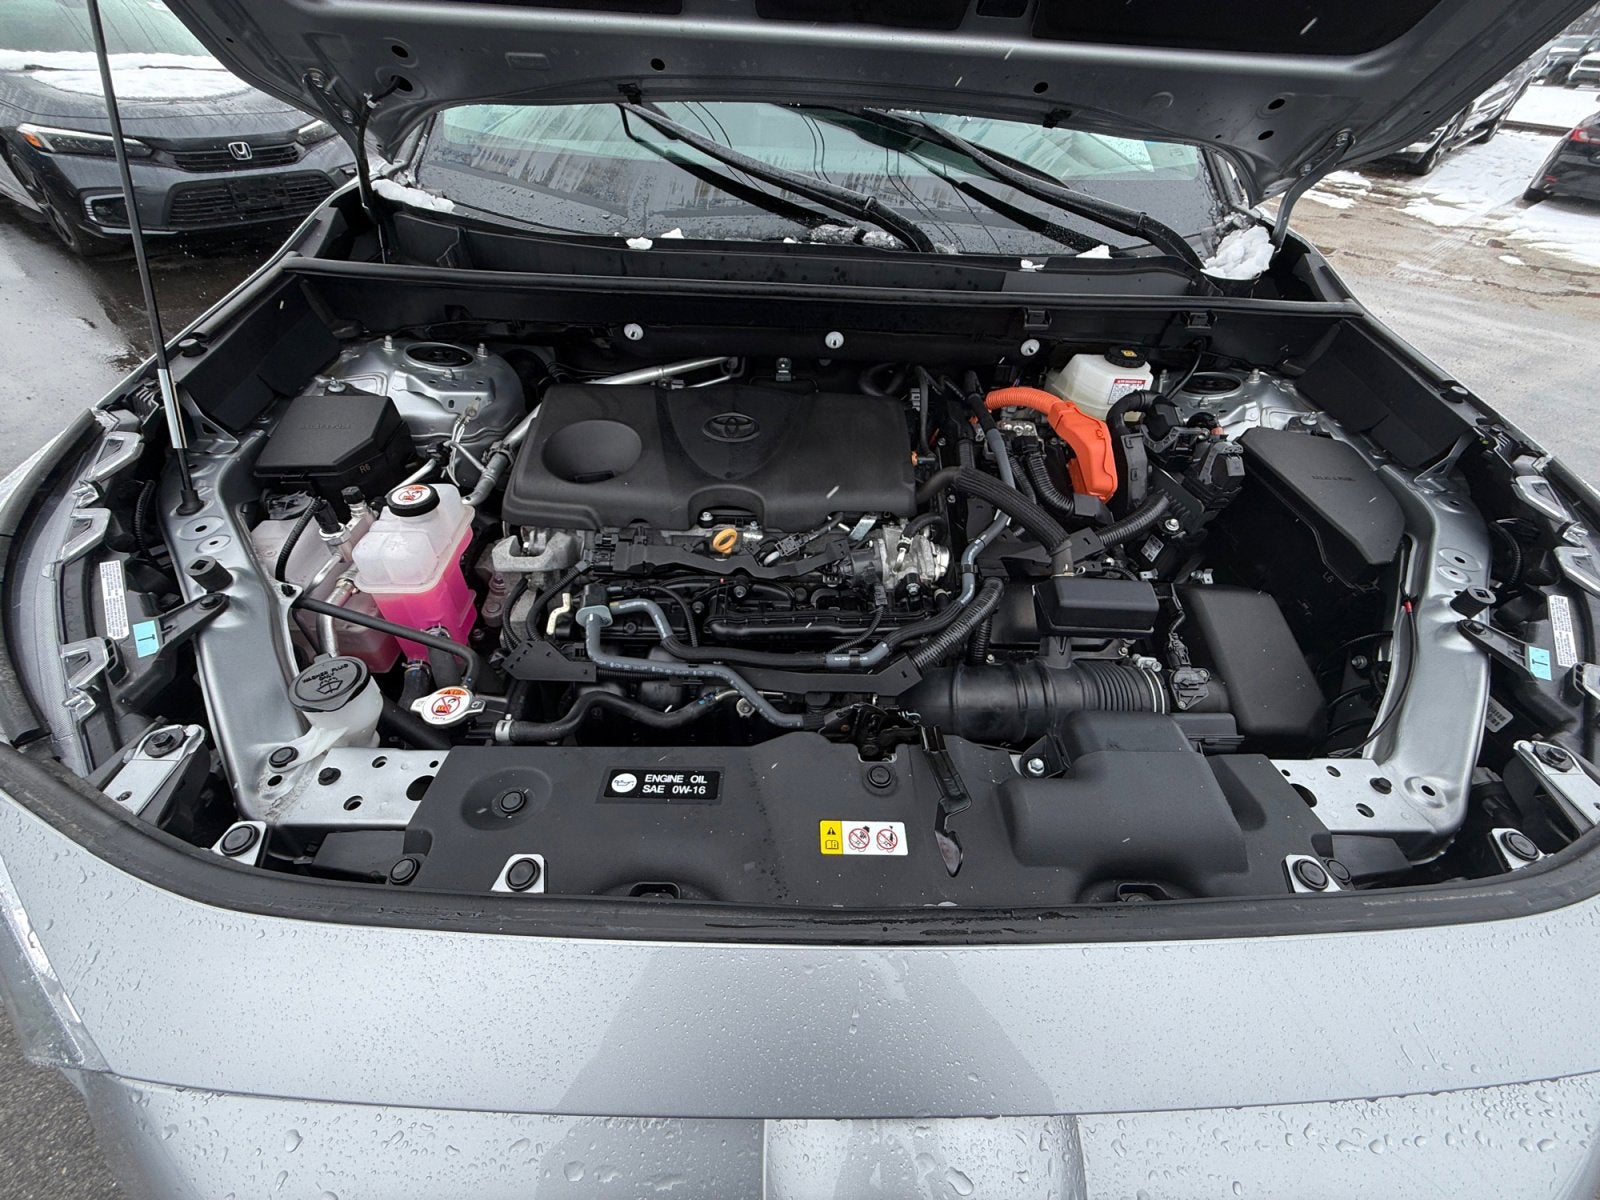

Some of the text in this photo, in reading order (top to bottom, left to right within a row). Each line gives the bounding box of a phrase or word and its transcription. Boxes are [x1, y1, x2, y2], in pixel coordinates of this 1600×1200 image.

[644, 773, 708, 784] ENGINE OIL
[642, 784, 707, 795] SAE 0W-16
